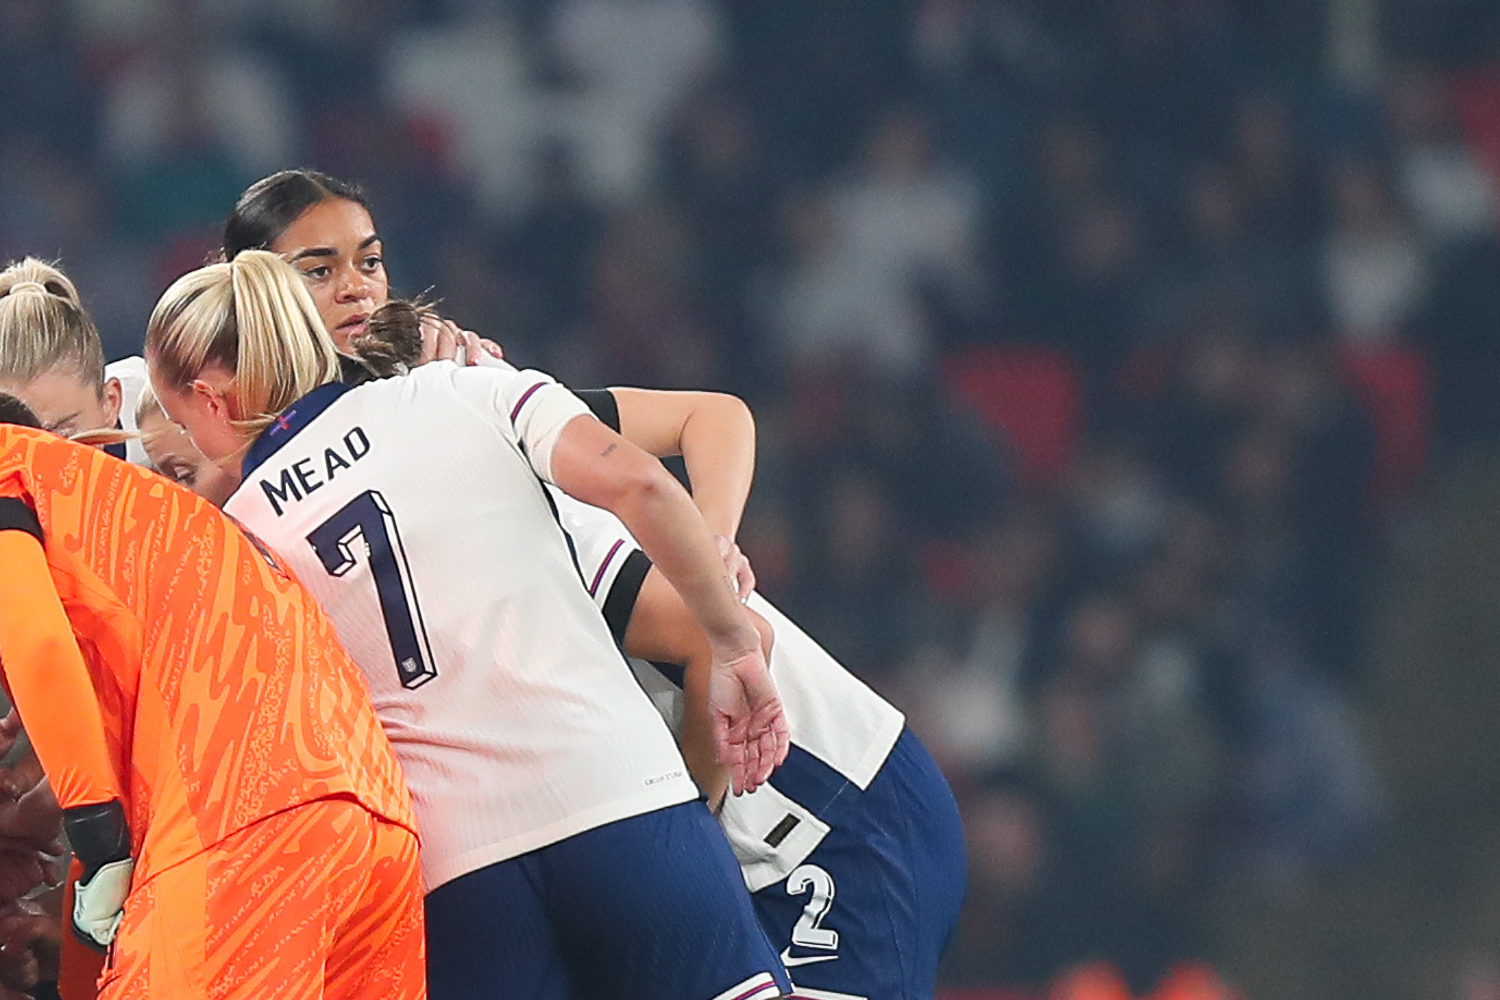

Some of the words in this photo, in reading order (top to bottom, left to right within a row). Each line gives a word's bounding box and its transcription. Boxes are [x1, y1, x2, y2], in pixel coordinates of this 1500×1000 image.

[259, 426, 371, 517] MEAD
[305, 489, 438, 691] 7
[786, 864, 839, 950] 2
